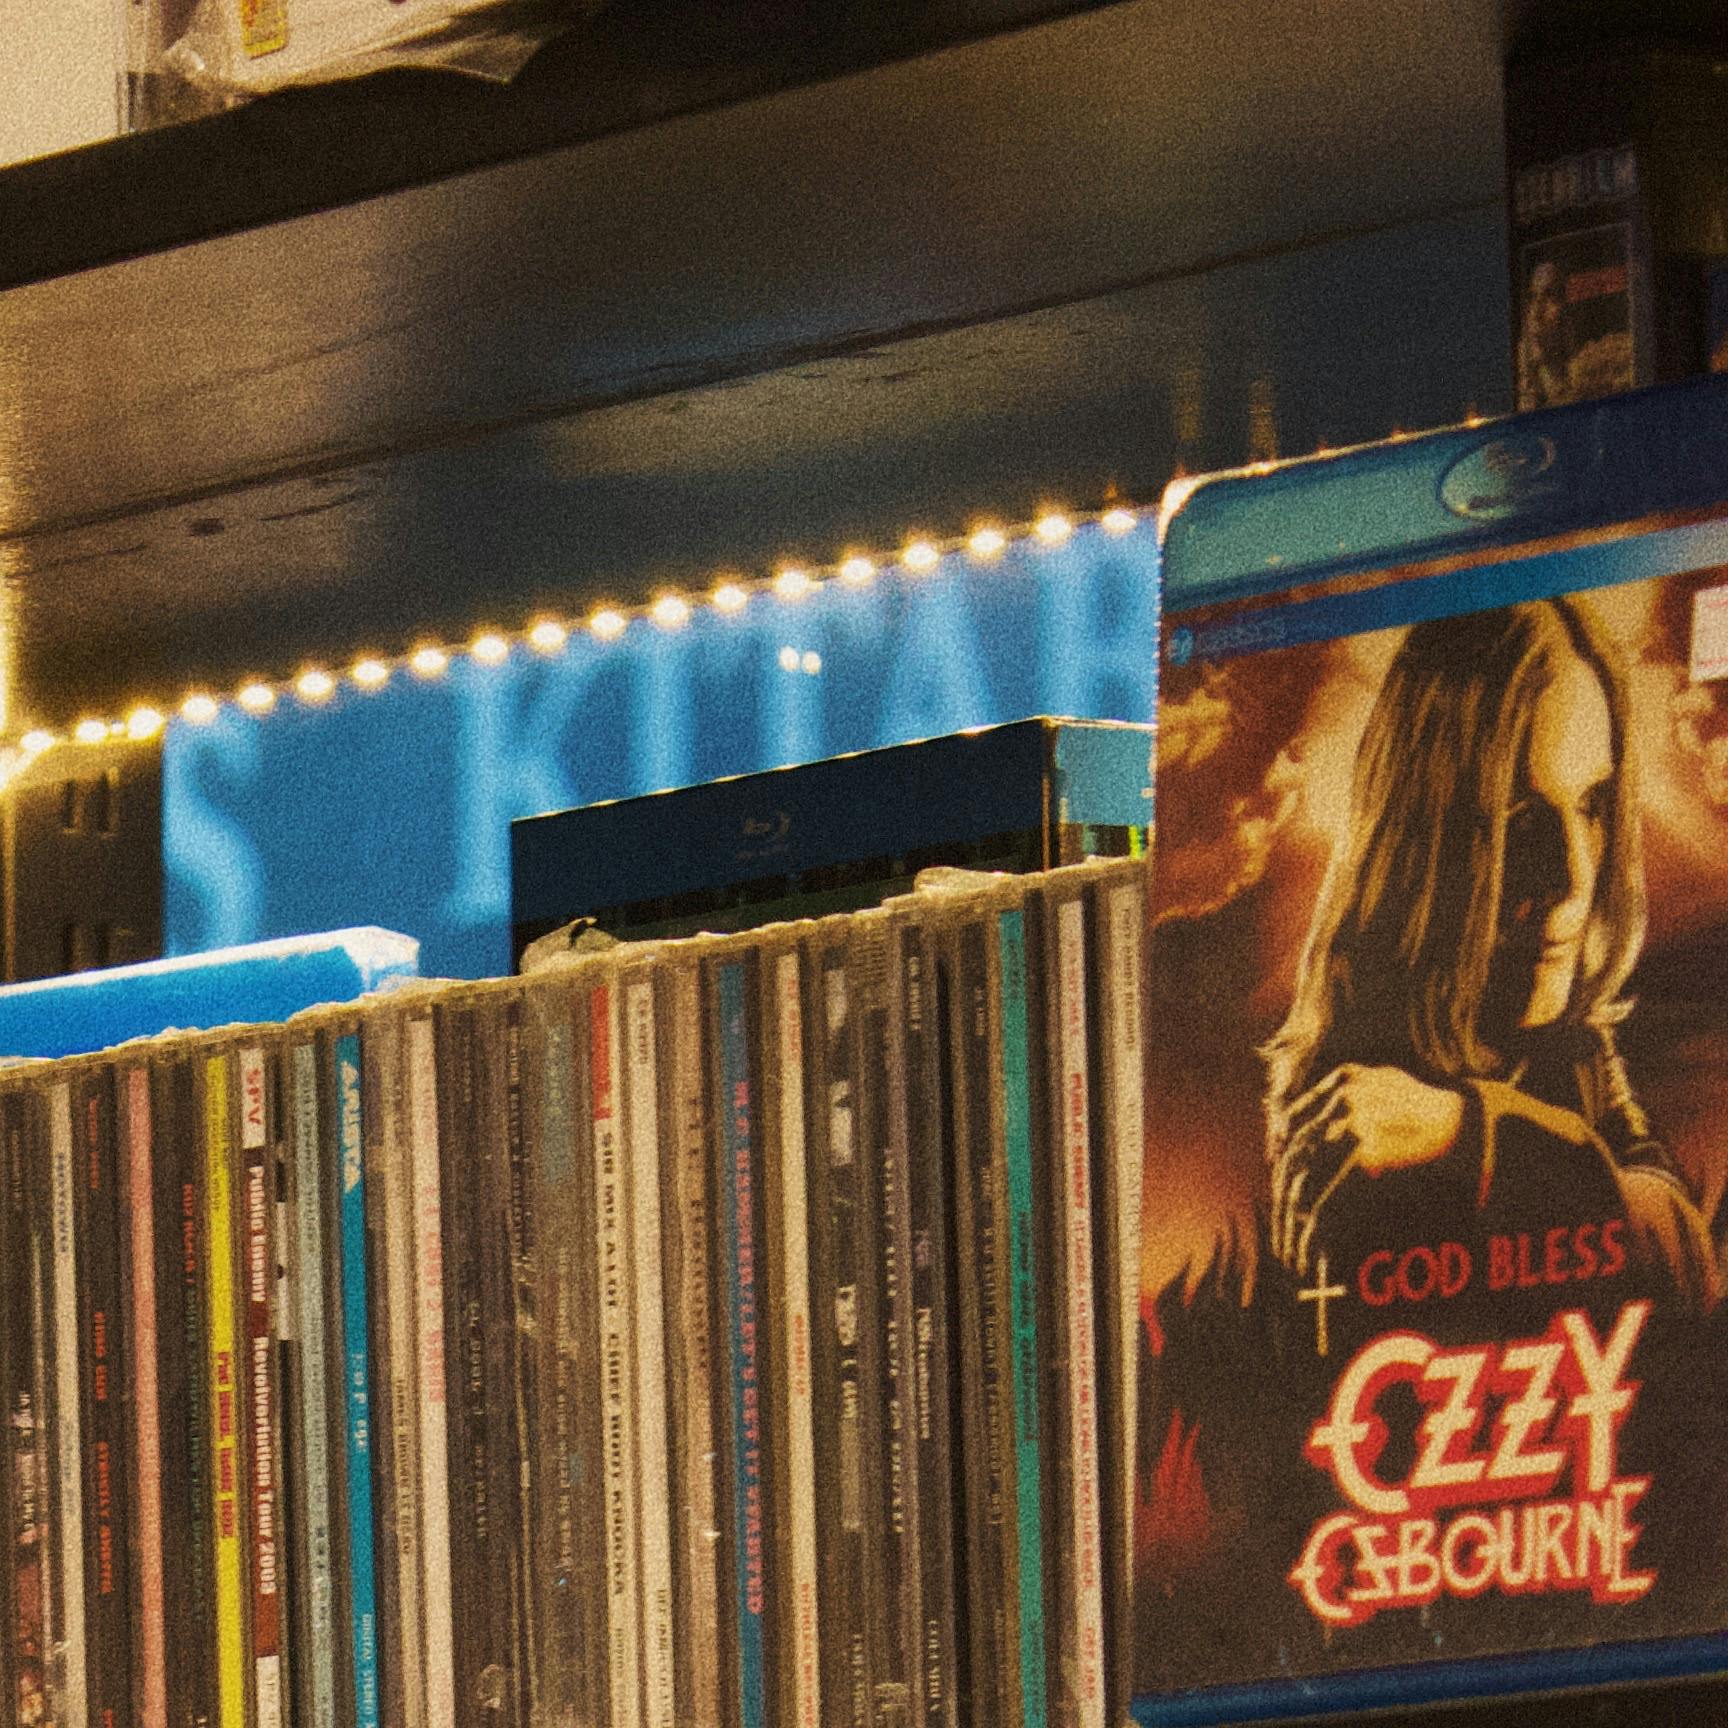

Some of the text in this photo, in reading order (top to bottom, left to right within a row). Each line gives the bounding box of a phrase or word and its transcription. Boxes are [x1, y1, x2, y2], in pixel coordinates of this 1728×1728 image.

[245, 1066, 263, 1127] SPV
[339, 1059, 365, 1194] ARISTA
[247, 1165, 266, 1231] Public
[248, 1233, 269, 1303] Enemy
[1357, 1219, 1627, 1307] GOD BLESS
[1309, 1301, 1652, 1514] OZZY
[257, 1490, 275, 1536] Tour
[741, 1483, 765, 1615] STARTED
[1290, 1480, 1656, 1620] OSBOURNE
